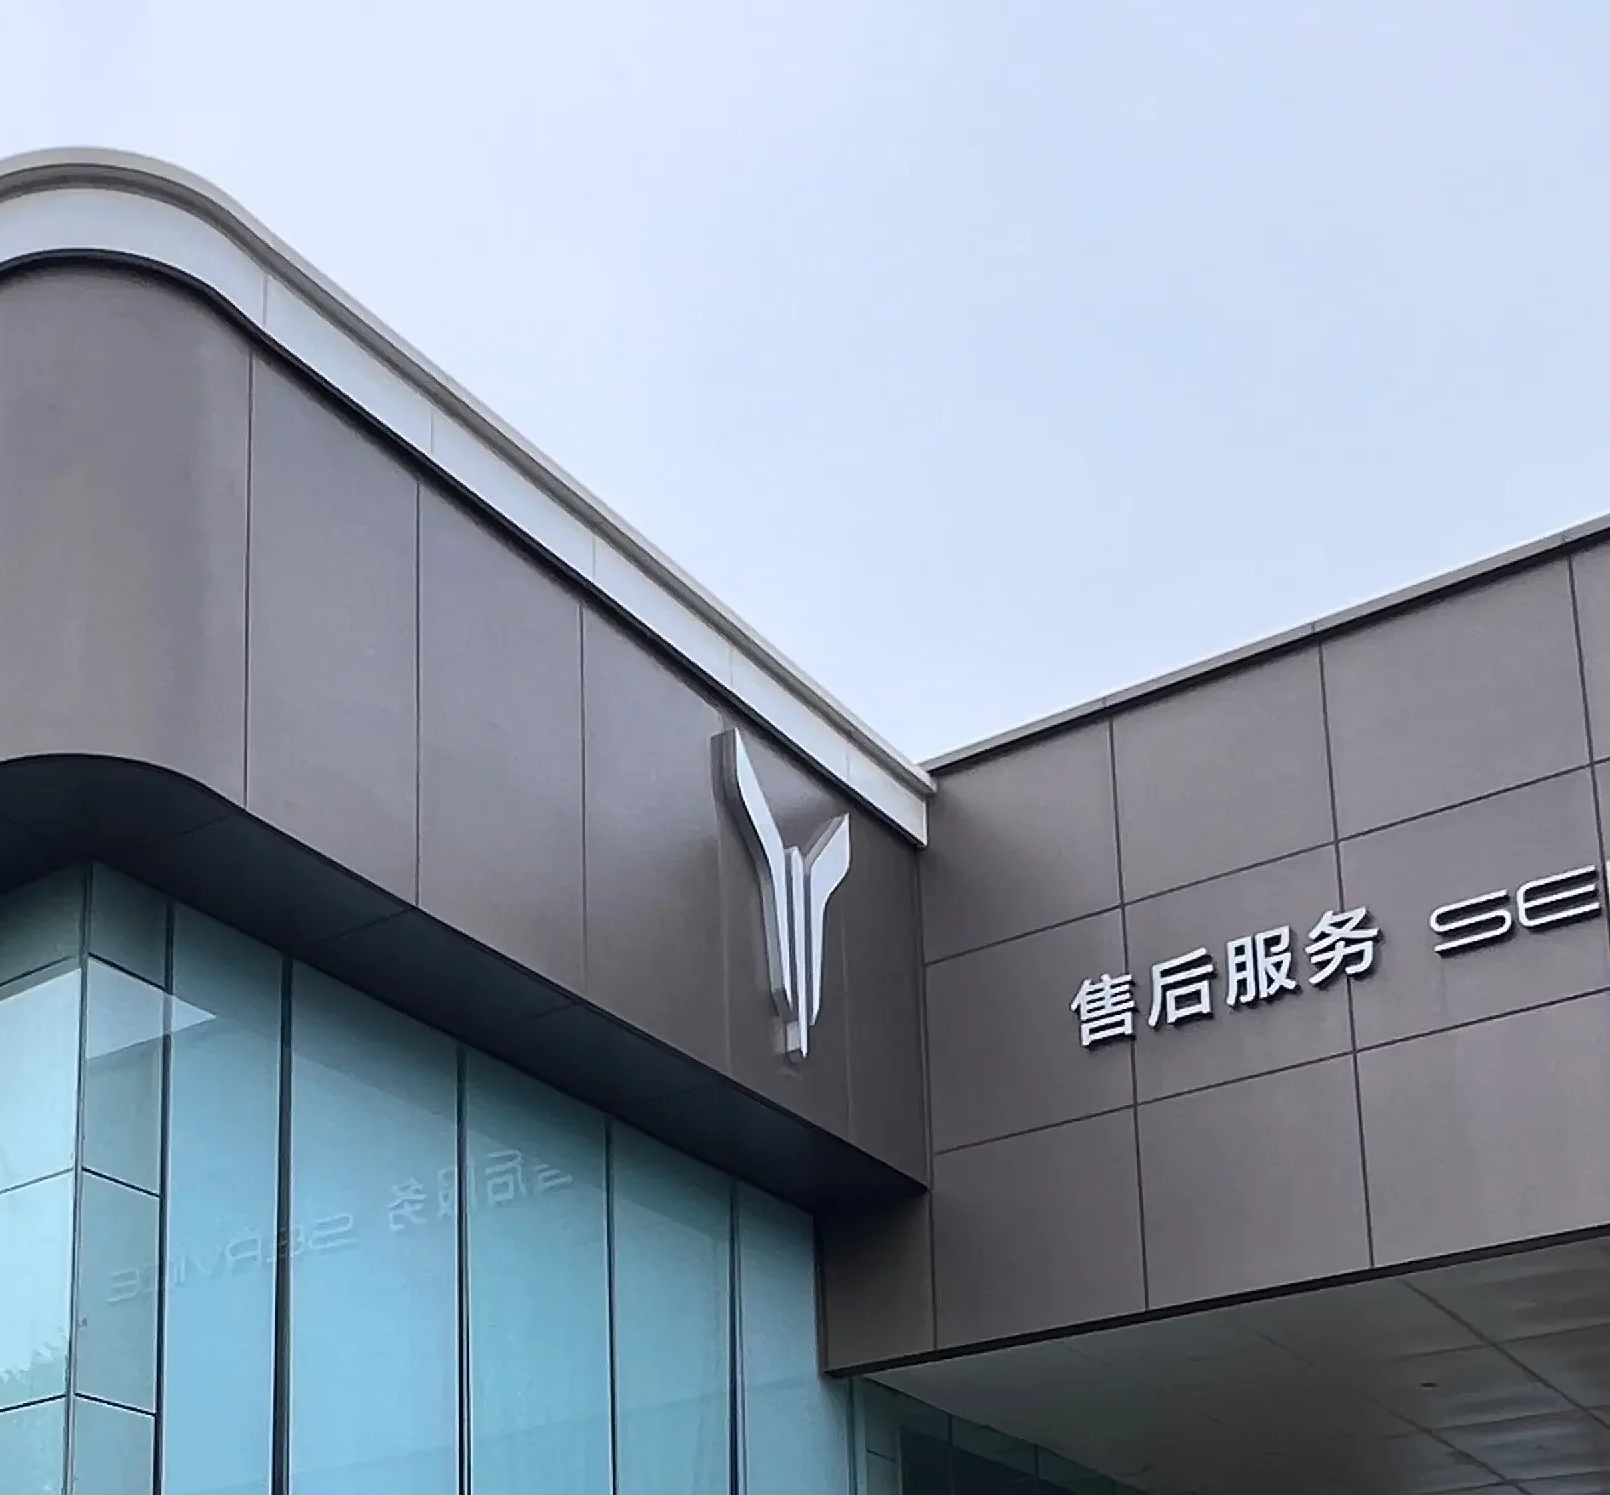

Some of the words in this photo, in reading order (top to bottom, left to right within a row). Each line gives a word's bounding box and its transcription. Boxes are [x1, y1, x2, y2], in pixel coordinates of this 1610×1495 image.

[1070, 905, 1381, 1049] 售后服务
[1428, 858, 1610, 955] SE
